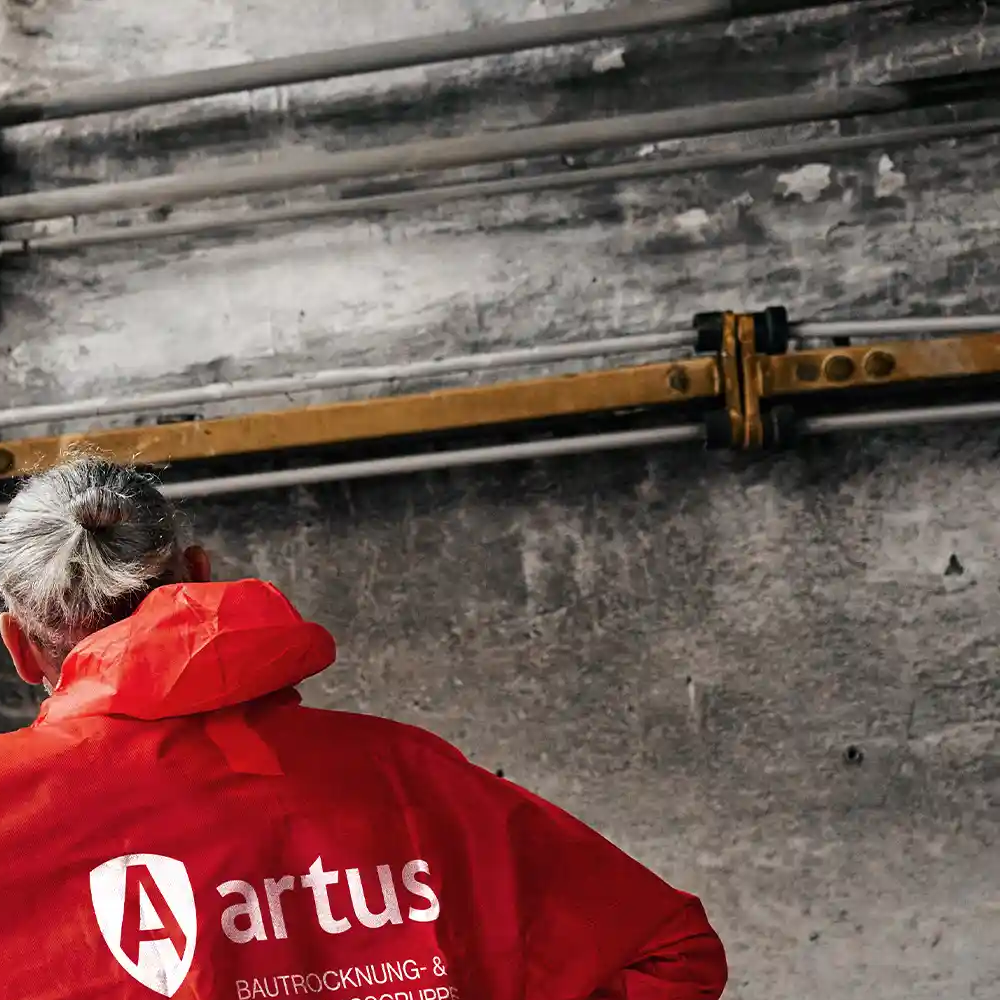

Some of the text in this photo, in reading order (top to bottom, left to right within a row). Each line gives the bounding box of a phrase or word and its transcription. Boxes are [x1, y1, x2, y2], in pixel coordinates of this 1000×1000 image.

[120, 856, 440, 967] A artus
[236, 956, 447, 1000] BAUTROCKNUNG- &
